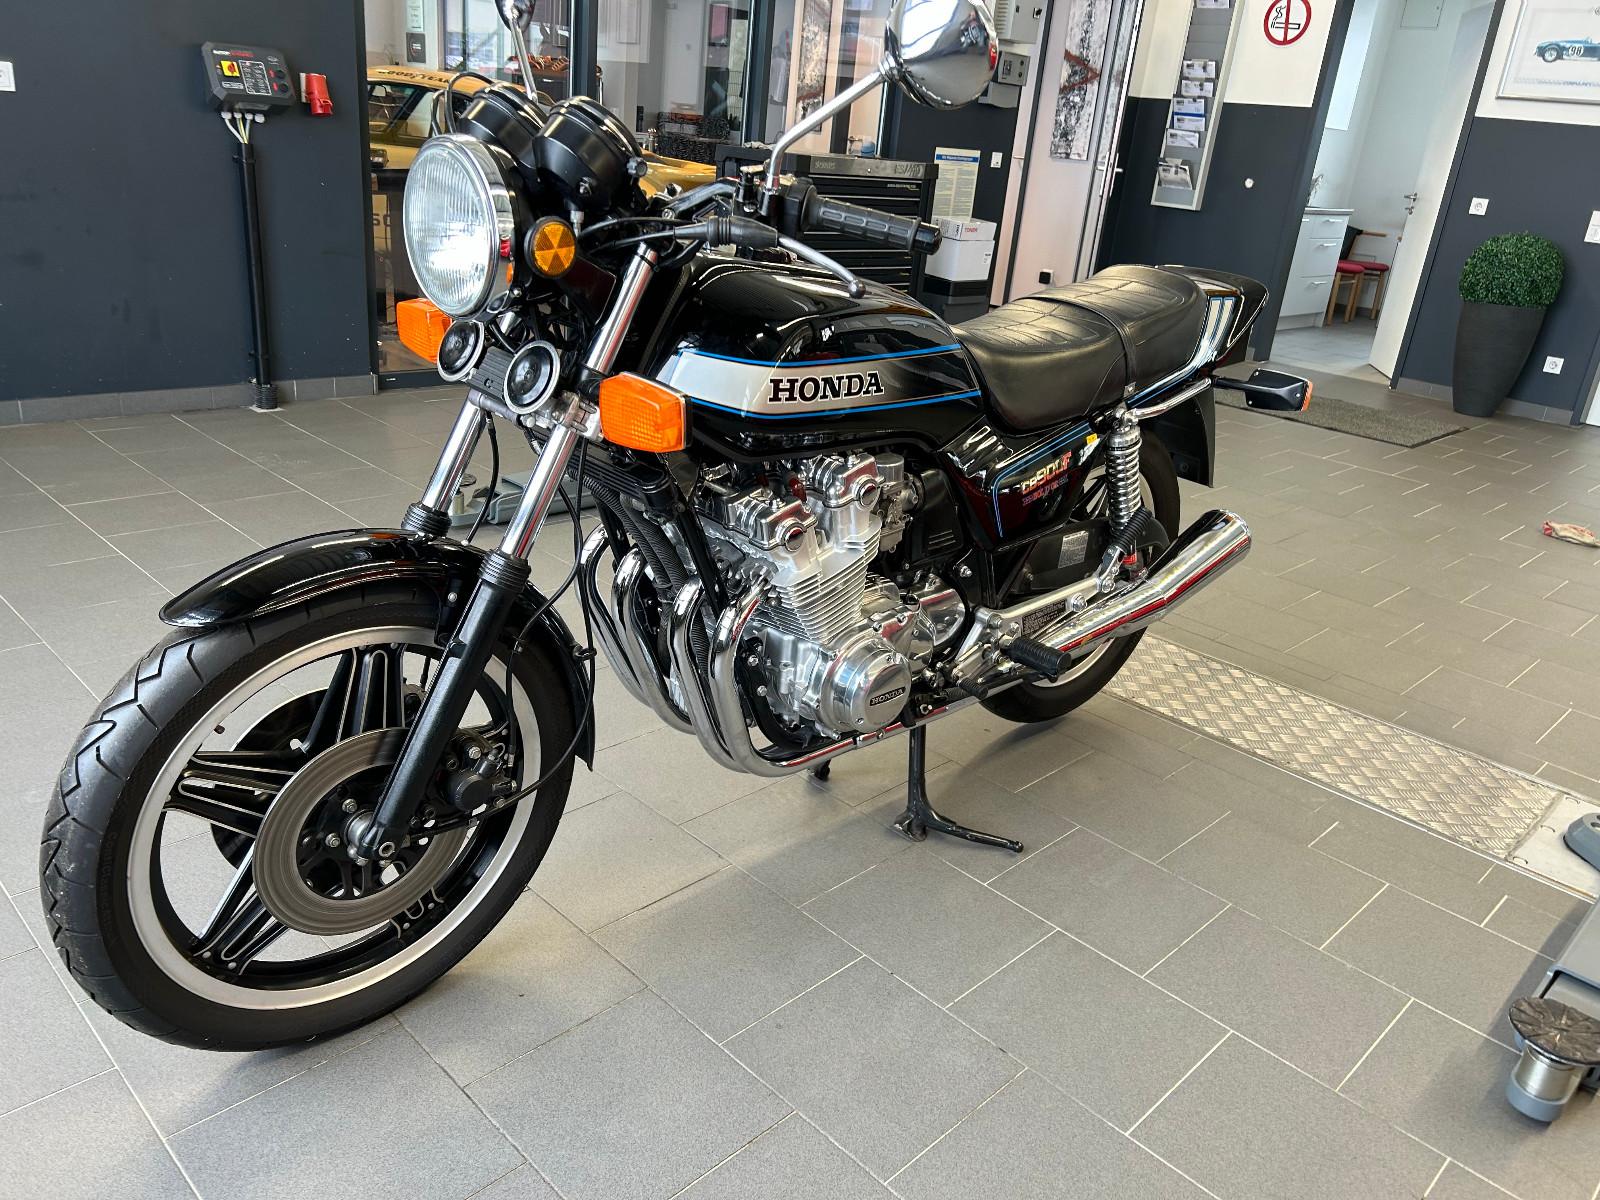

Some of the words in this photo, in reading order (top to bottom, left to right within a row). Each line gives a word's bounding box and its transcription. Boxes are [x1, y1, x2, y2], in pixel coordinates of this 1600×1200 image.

[1570, 45, 1583, 56] 98
[768, 371, 884, 404] HONDA
[871, 688, 904, 704] HONDA
